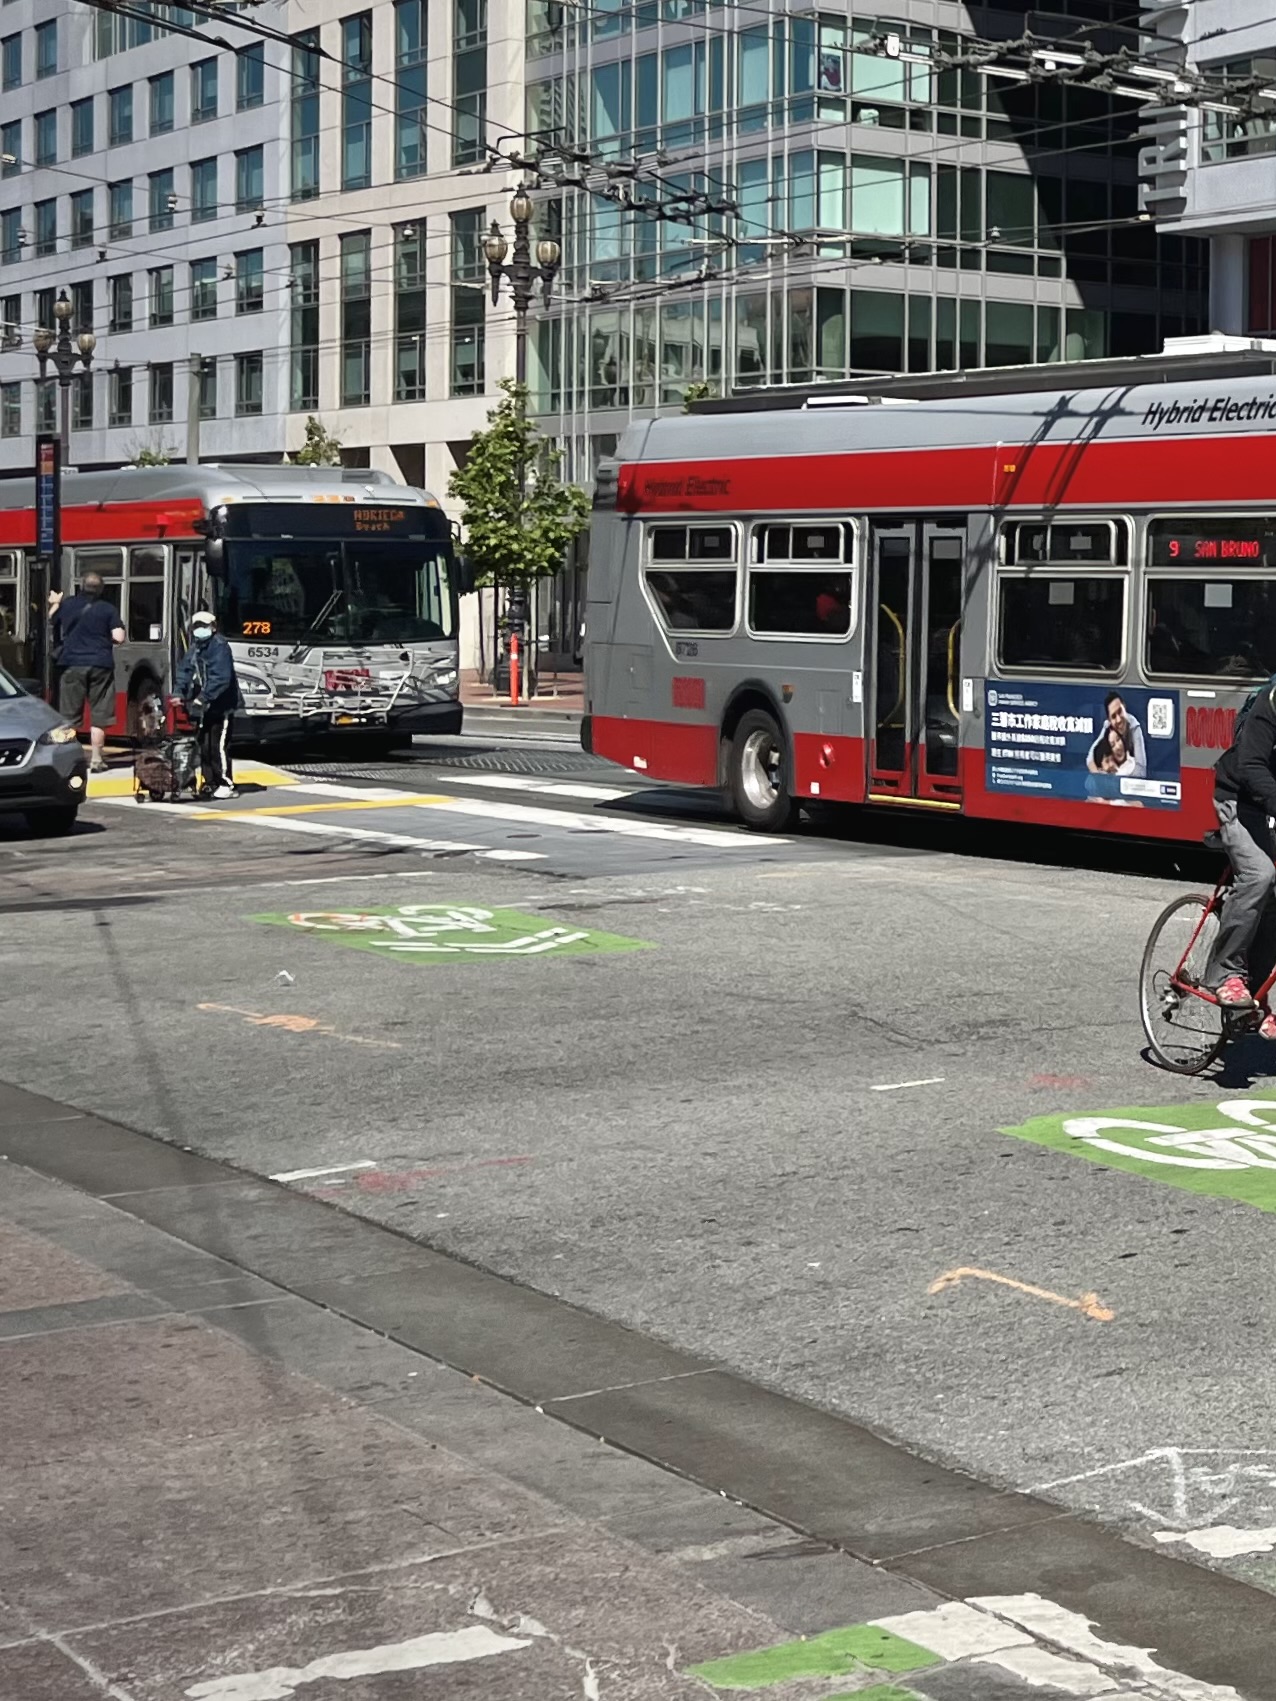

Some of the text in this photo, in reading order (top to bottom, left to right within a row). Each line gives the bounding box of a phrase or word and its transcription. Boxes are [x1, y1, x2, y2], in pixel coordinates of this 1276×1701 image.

[1141, 397, 1209, 431] Hybrid
[1168, 540, 1260, 558] 9 SAN BRUNO
[242, 621, 271, 635] 278
[247, 646, 279, 658] 6534
